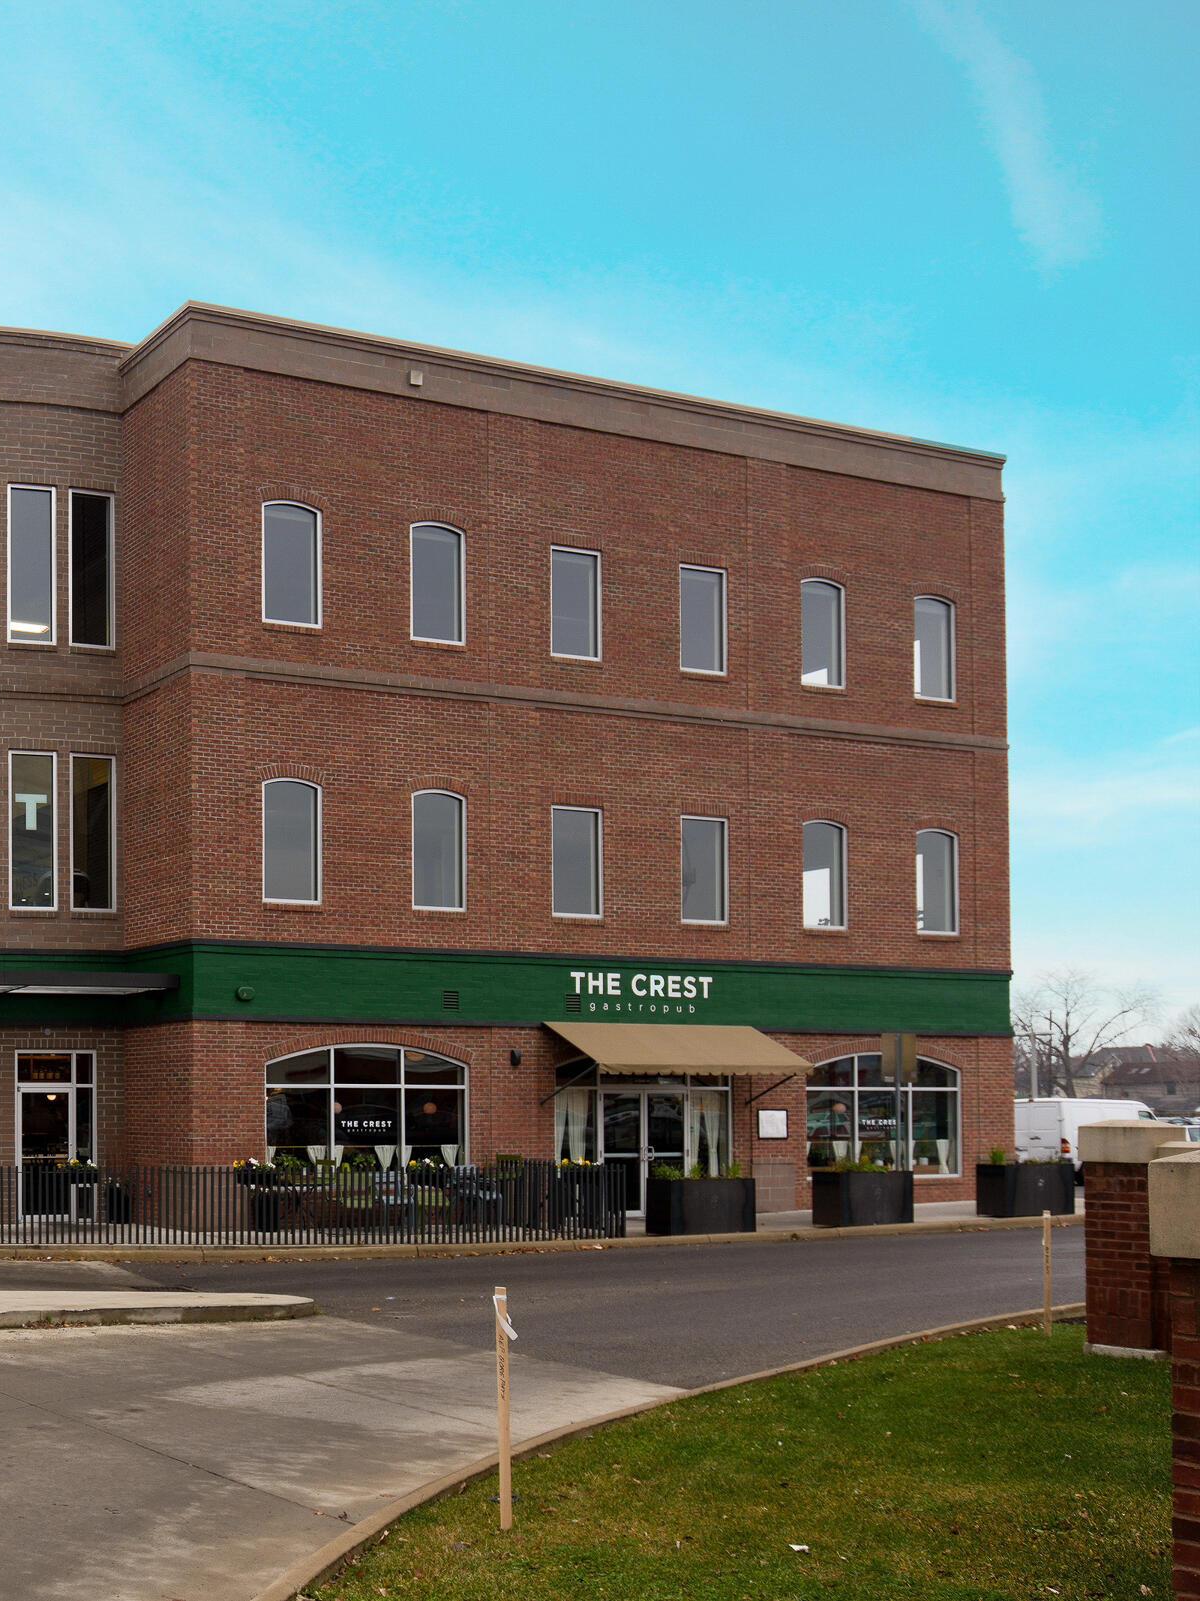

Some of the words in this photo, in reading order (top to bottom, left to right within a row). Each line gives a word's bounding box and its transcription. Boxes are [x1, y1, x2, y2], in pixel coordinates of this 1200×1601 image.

[570, 971, 621, 995] THE
[631, 973, 713, 999] CREST
[589, 1002, 696, 1014] gastropub
[341, 1120, 359, 1128] THE
[362, 1120, 393, 1128] CREST
